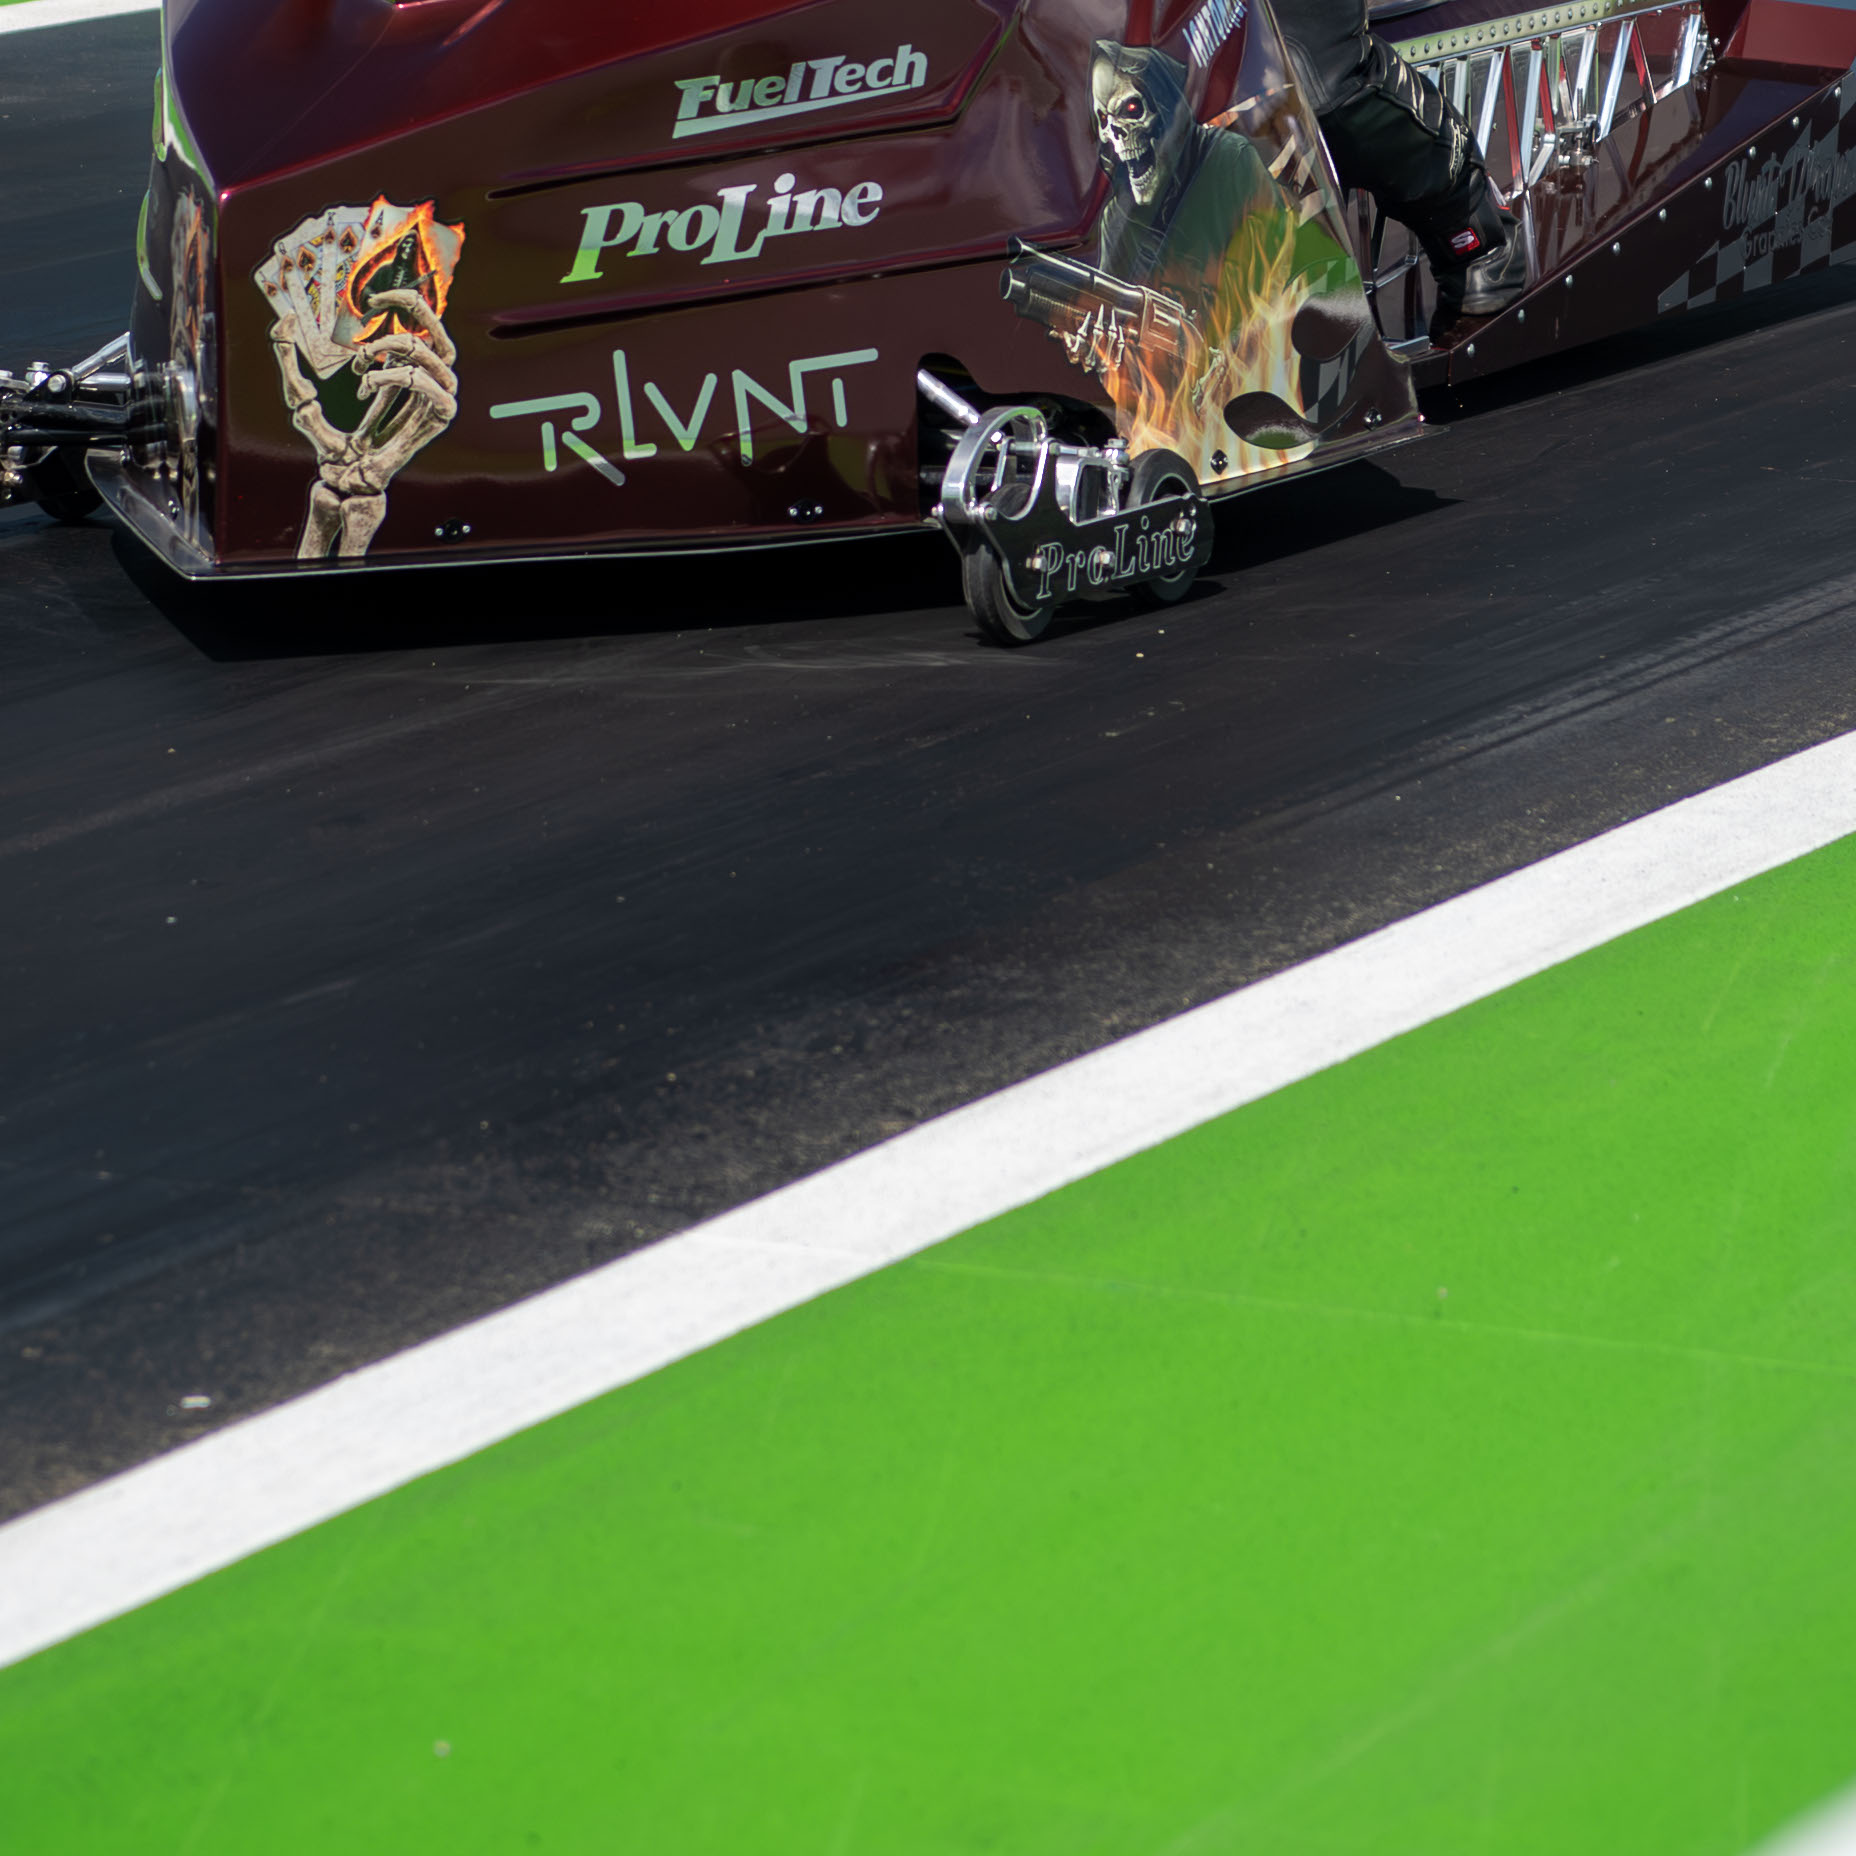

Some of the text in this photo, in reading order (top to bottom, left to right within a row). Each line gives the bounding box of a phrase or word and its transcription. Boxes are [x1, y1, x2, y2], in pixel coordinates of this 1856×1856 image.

[673, 43, 929, 122] FuelTech
[559, 172, 884, 284] ProLine
[489, 347, 879, 487] RLVNT
